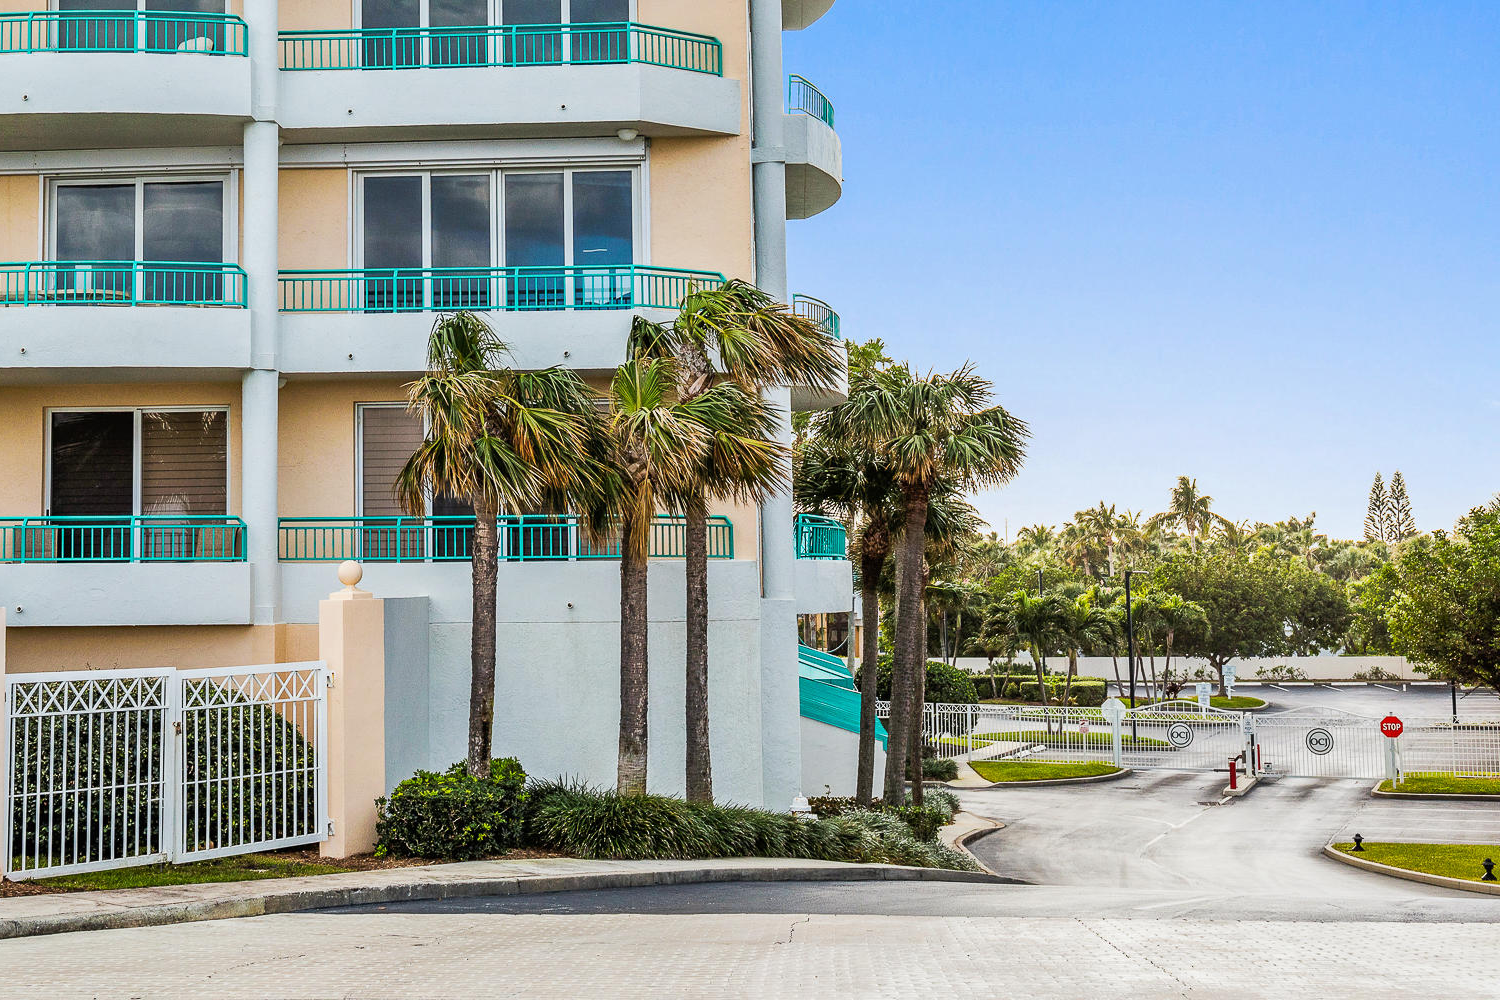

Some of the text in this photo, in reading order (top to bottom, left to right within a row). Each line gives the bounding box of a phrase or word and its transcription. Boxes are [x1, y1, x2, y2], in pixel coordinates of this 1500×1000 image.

[1382, 722, 1401, 731] STOP
[1171, 730, 1190, 741] OCJ
[1309, 737, 1329, 747] OCJ
